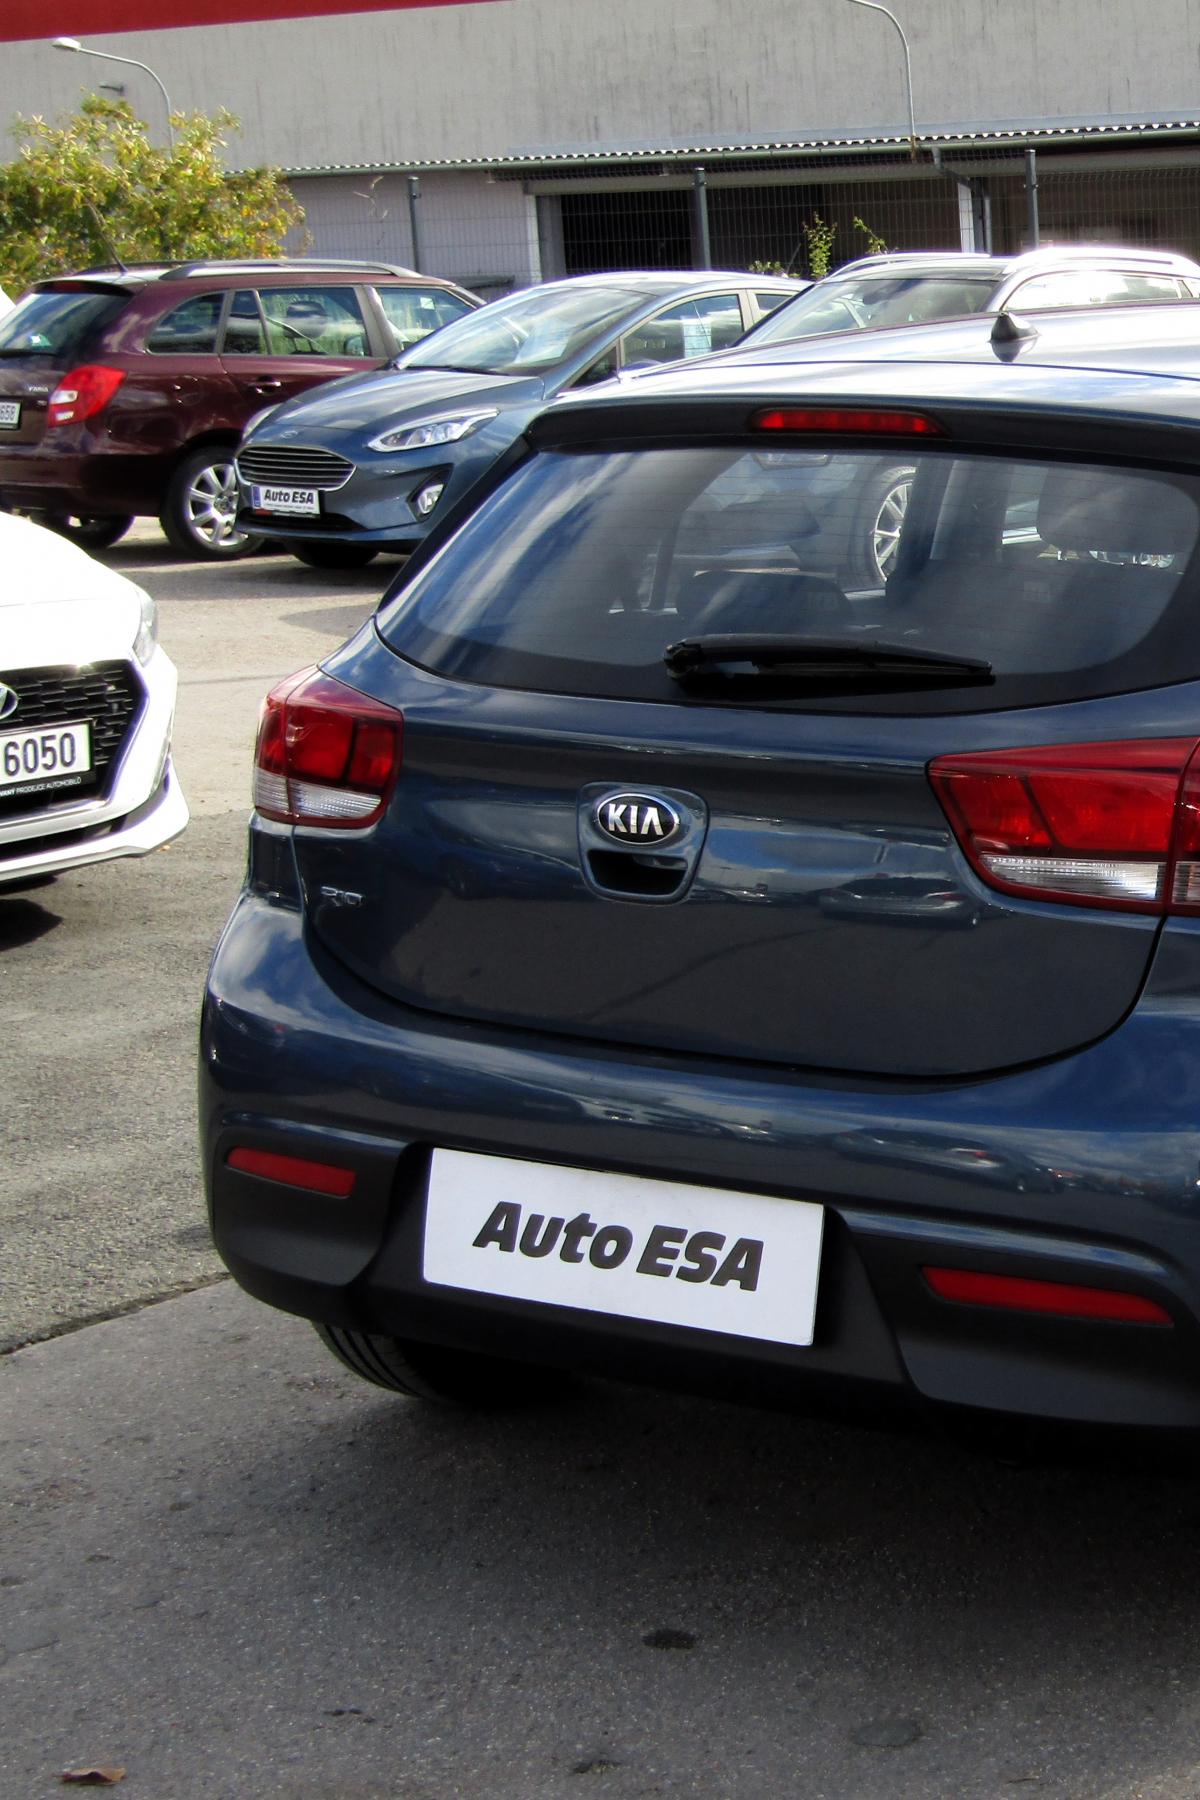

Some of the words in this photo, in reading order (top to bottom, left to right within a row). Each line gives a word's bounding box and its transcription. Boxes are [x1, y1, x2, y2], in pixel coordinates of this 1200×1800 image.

[264, 489, 290, 502] Auto
[292, 492, 314, 504] ESA
[4, 732, 76, 776] 6050
[608, 803, 664, 836] KIA
[472, 1201, 634, 1270] Auto
[636, 1224, 764, 1292] ESA
